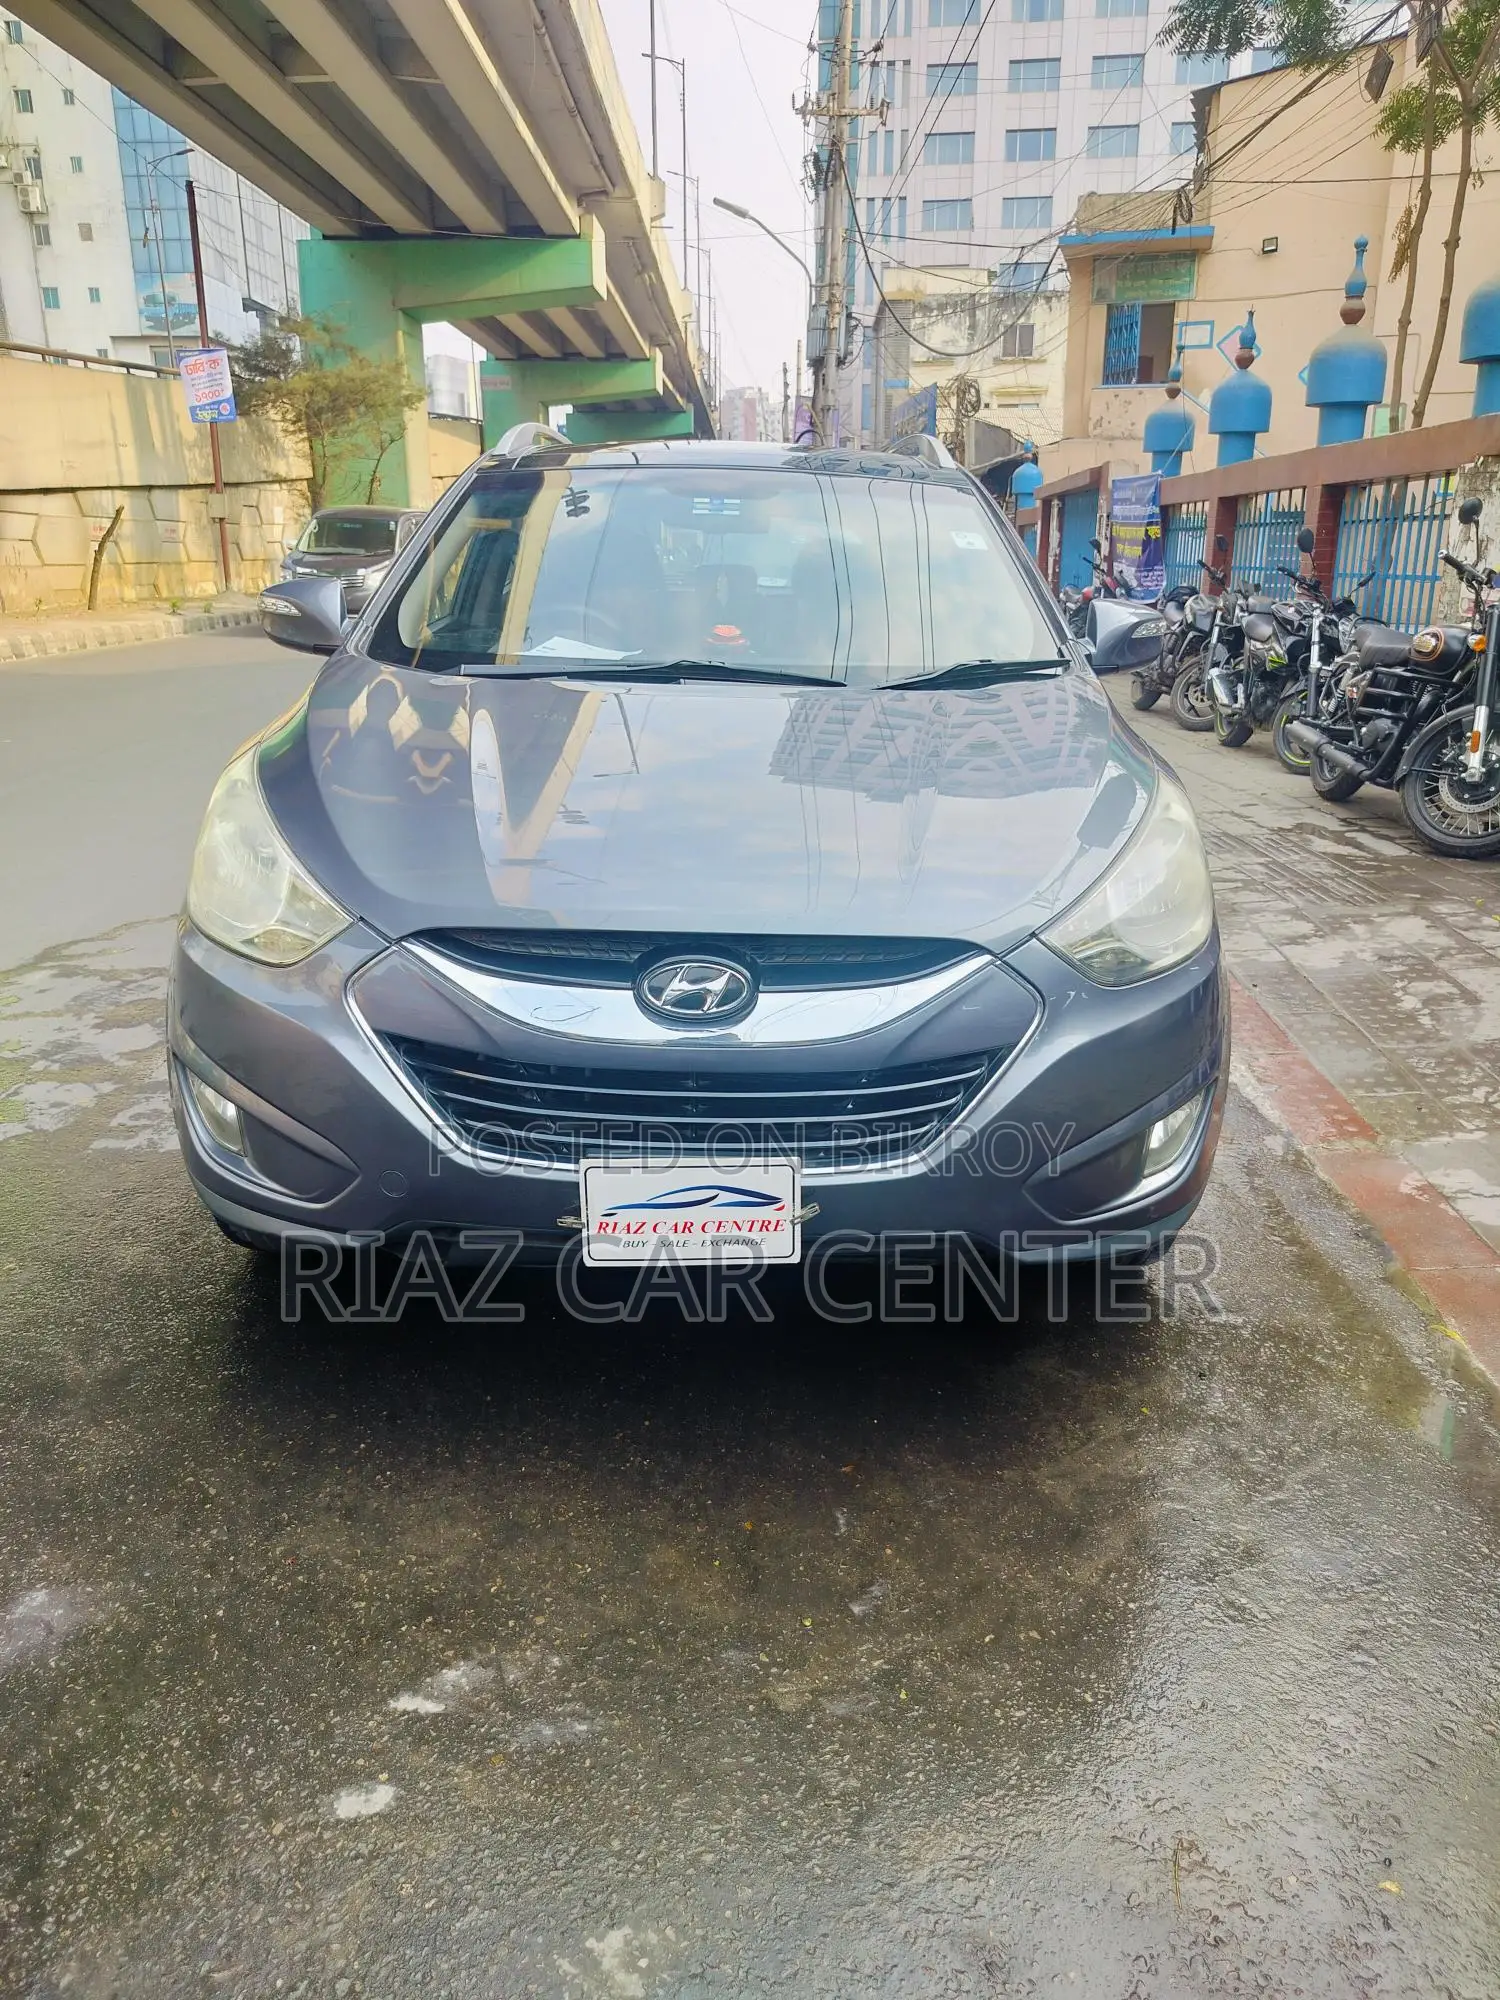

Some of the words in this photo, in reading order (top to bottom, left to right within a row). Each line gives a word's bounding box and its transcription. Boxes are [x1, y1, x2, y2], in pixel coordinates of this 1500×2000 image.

[596, 1221, 647, 1236] RIAZ
[652, 1220, 694, 1235] CAR
[700, 1218, 787, 1234] CENTRE
[622, 1240, 648, 1249] BUY
[660, 1239, 690, 1248] SALE
[700, 1237, 767, 1248] EXCHANGE
